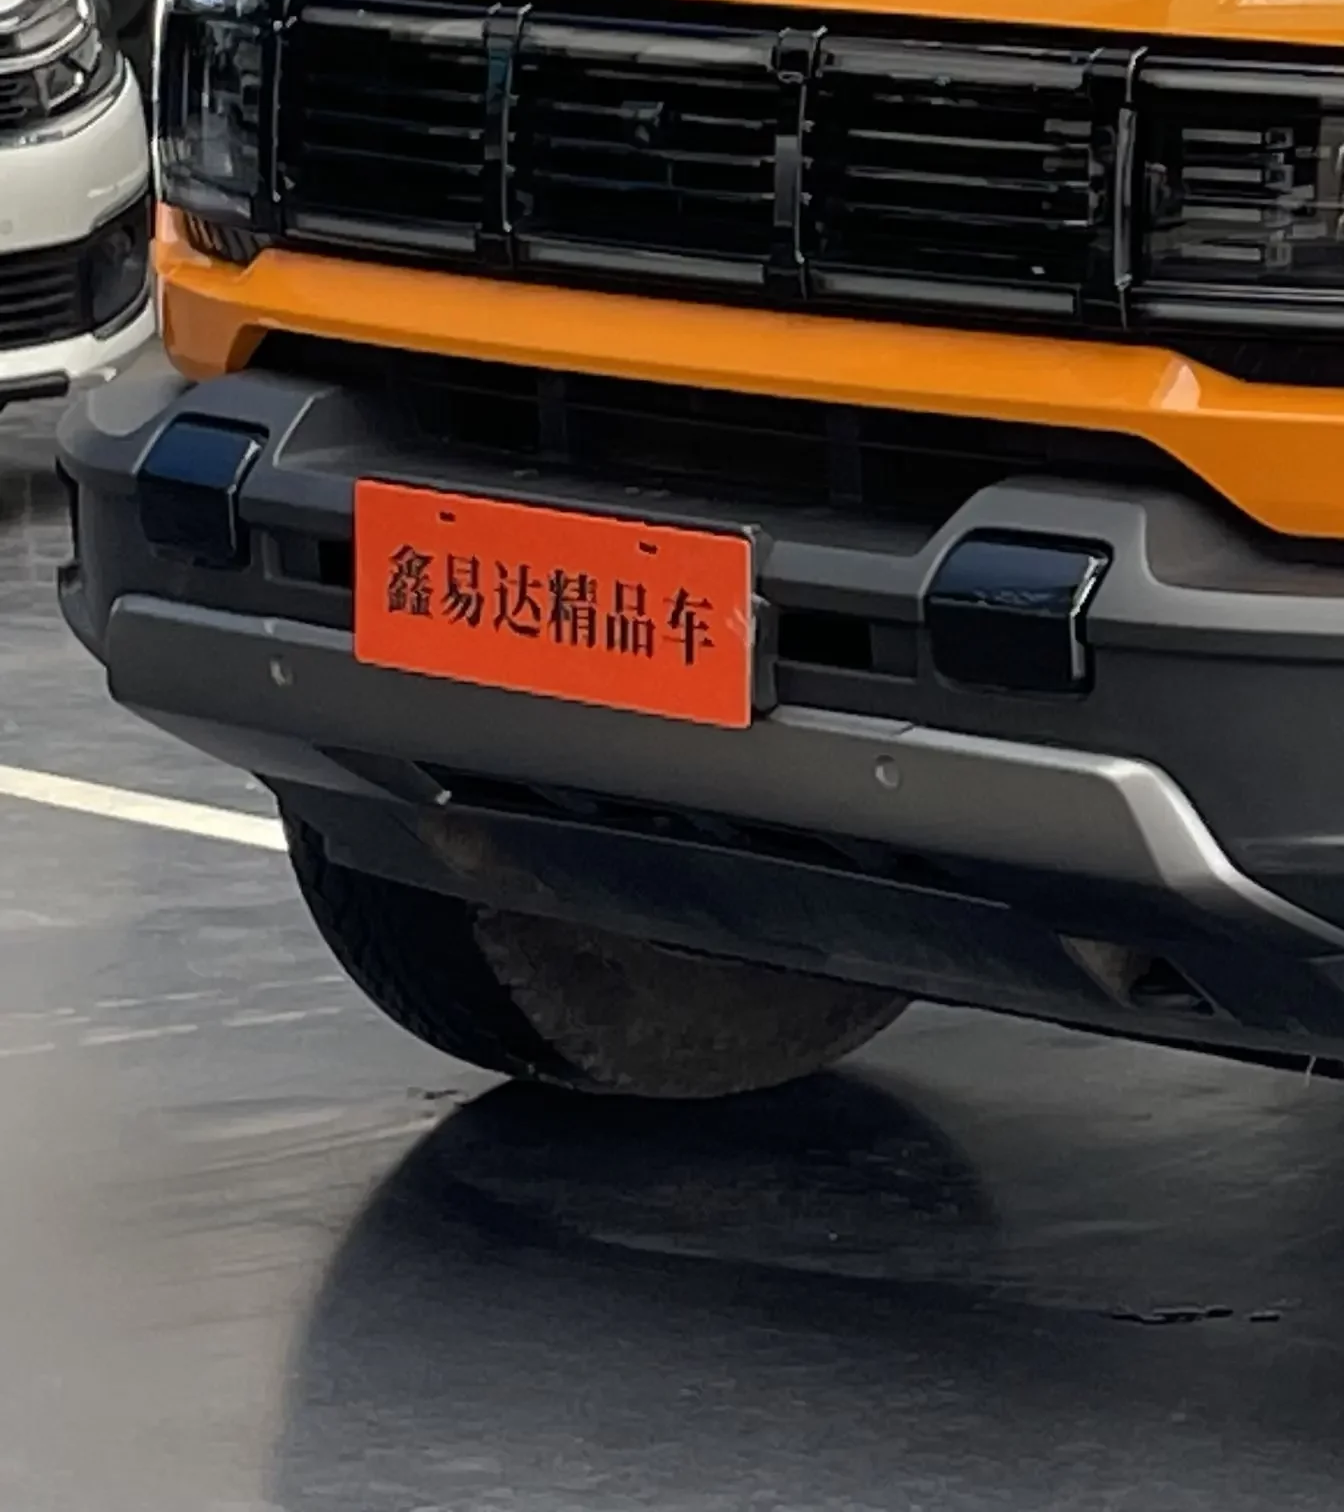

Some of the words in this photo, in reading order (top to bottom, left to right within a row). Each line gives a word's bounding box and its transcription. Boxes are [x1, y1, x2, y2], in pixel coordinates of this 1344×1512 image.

[387, 543, 716, 667] 鑫易达精品车
